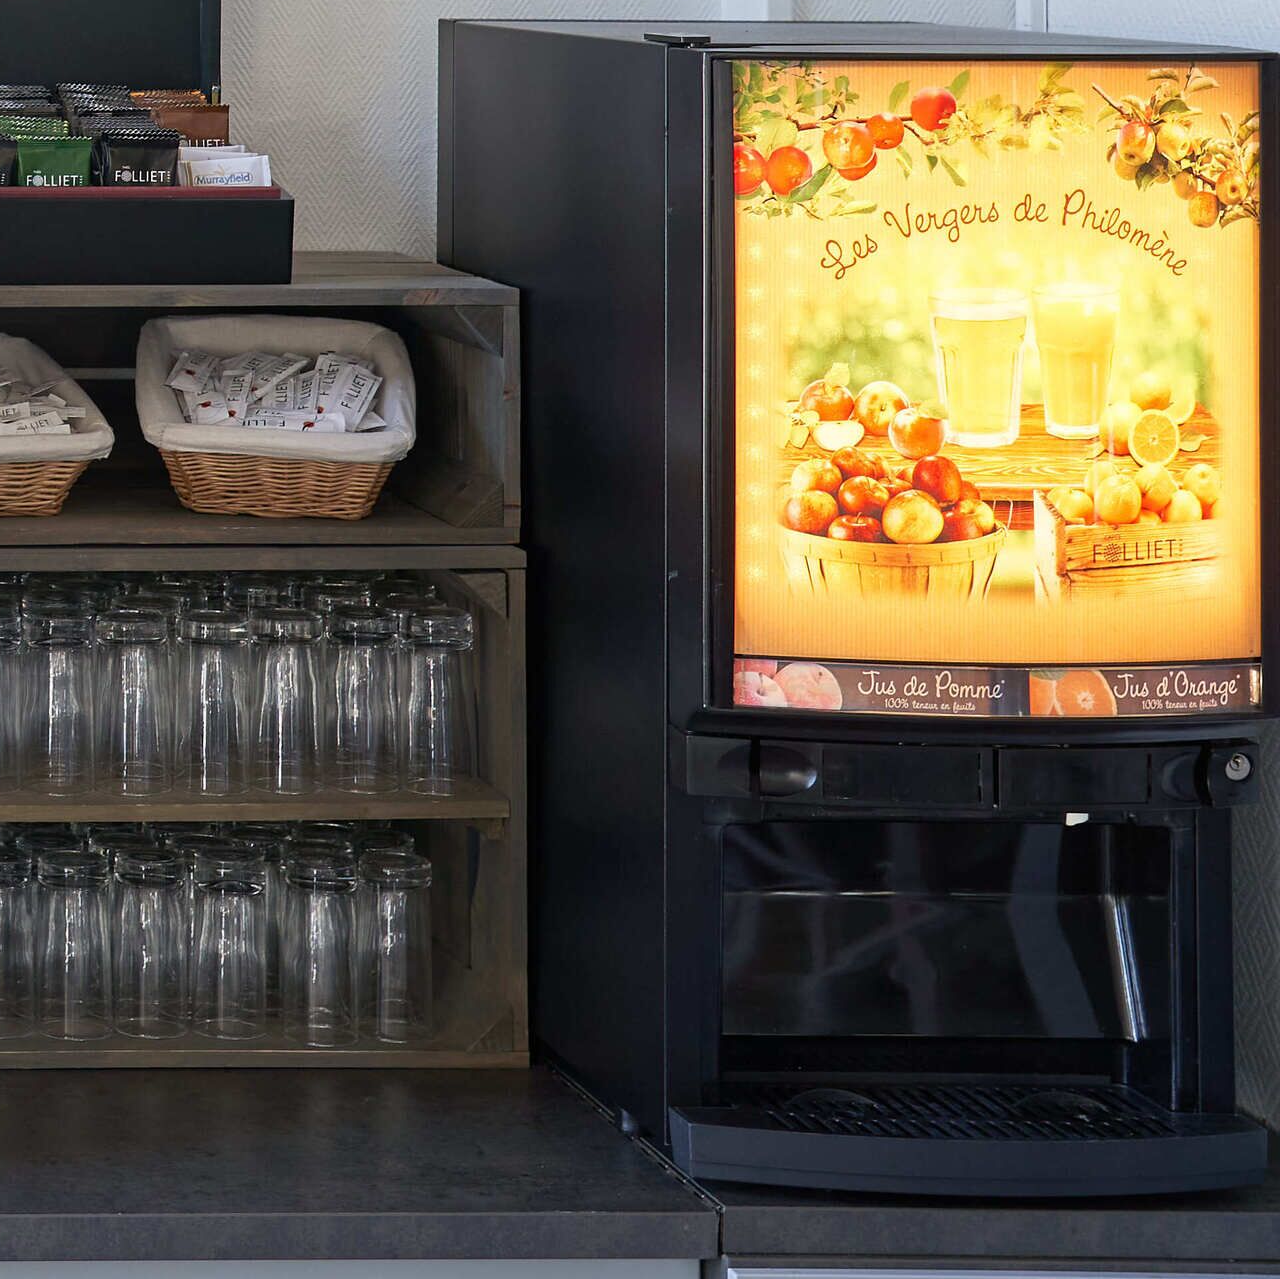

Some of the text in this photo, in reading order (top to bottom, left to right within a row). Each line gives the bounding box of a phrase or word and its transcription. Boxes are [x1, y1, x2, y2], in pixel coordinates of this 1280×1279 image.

[26, 174, 79, 187] FOLLIET
[115, 170, 167, 183] FOLLIET
[195, 172, 251, 185] Murrayfield
[820, 188, 1188, 280] Les Vergers de Philomène
[1092, 538, 1177, 563] FOLLIET
[857, 670, 897, 695] Jus
[903, 675, 929, 696] de
[1113, 673, 1149, 699] Jus
[884, 698, 909, 709] 100%
[1142, 699, 1164, 710] 100%
